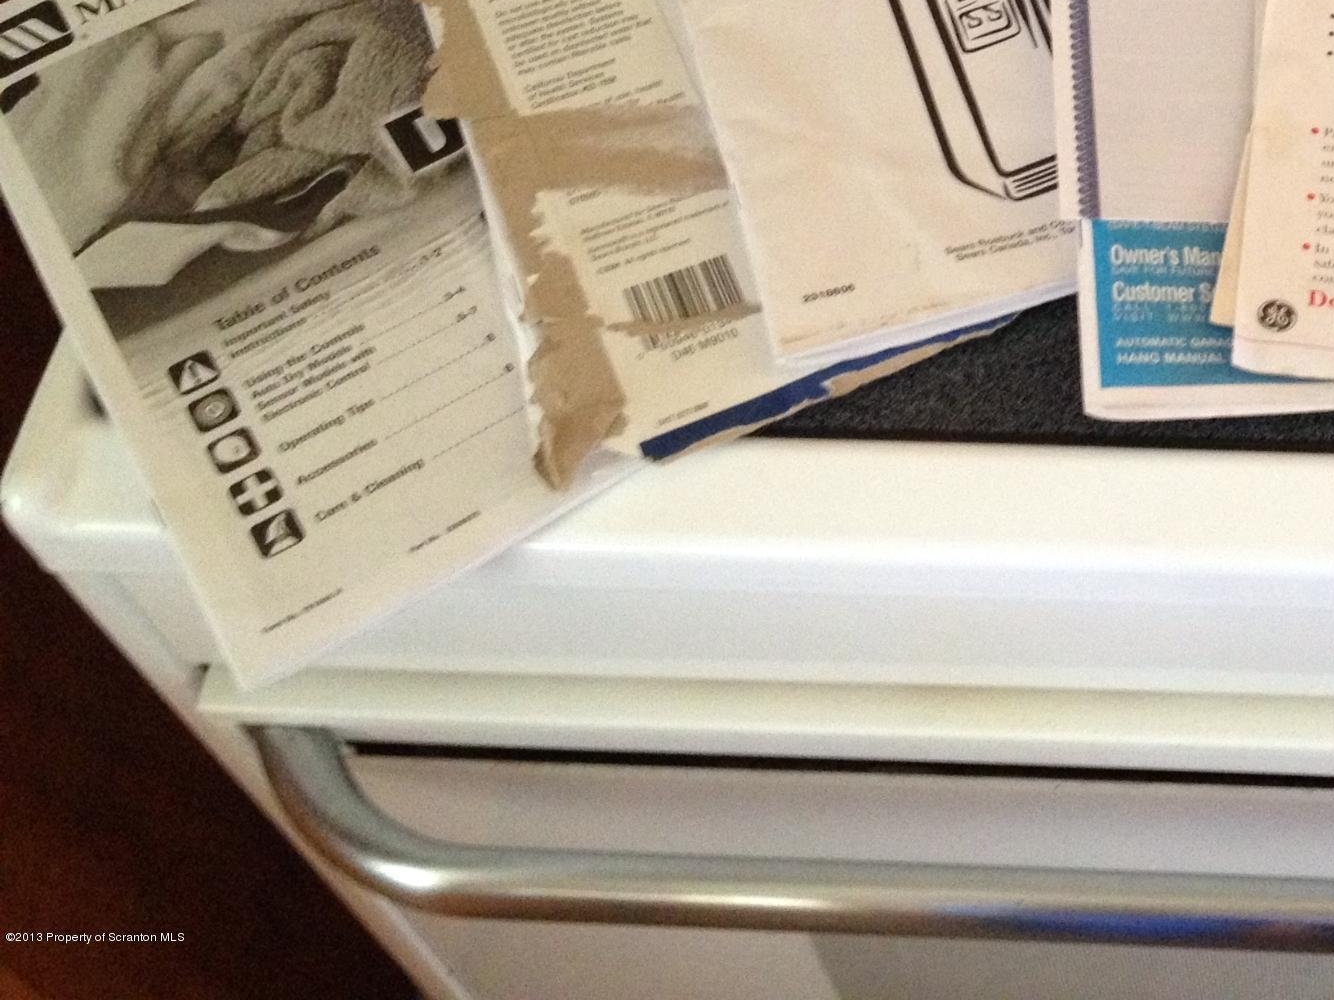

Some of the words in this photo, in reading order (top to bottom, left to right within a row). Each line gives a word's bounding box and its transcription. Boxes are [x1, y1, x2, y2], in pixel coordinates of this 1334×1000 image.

[1111, 244, 1179, 265] Owner's
[213, 301, 266, 332] Table
[271, 287, 289, 306] of
[295, 243, 381, 293] Contents
[1112, 281, 1195, 302] Customer
[278, 413, 346, 454] Operating
